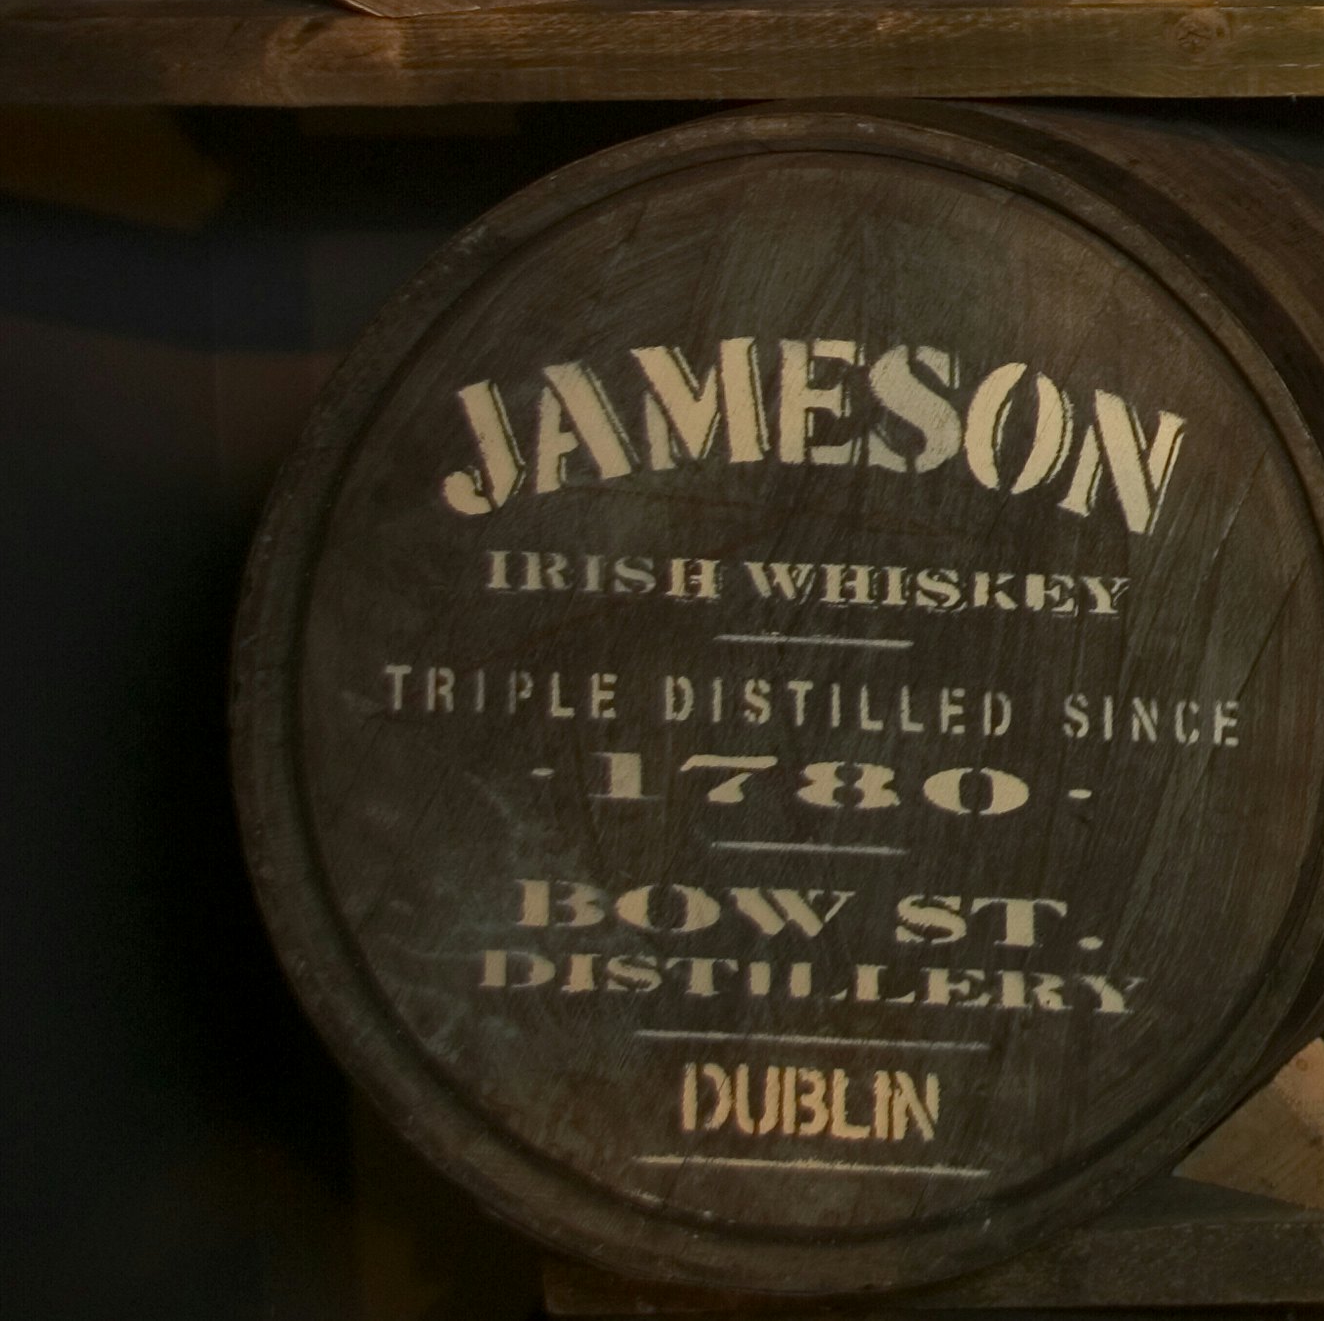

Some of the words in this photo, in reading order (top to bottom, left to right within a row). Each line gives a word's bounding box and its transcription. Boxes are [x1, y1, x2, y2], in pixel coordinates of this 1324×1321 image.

[441, 335, 1188, 535] JAMESON
[484, 549, 722, 599] IRISH
[744, 561, 1131, 616] WHISKEY
[384, 664, 620, 721] TRIPLE
[663, 676, 1014, 739] DISTILLED
[1061, 693, 1243, 748] SINCE
[513, 880, 858, 939] BOW
[891, 893, 1106, 952] ST.
[477, 950, 1147, 1016] DISTILLERY
[681, 1061, 940, 1143] DUBLIN
